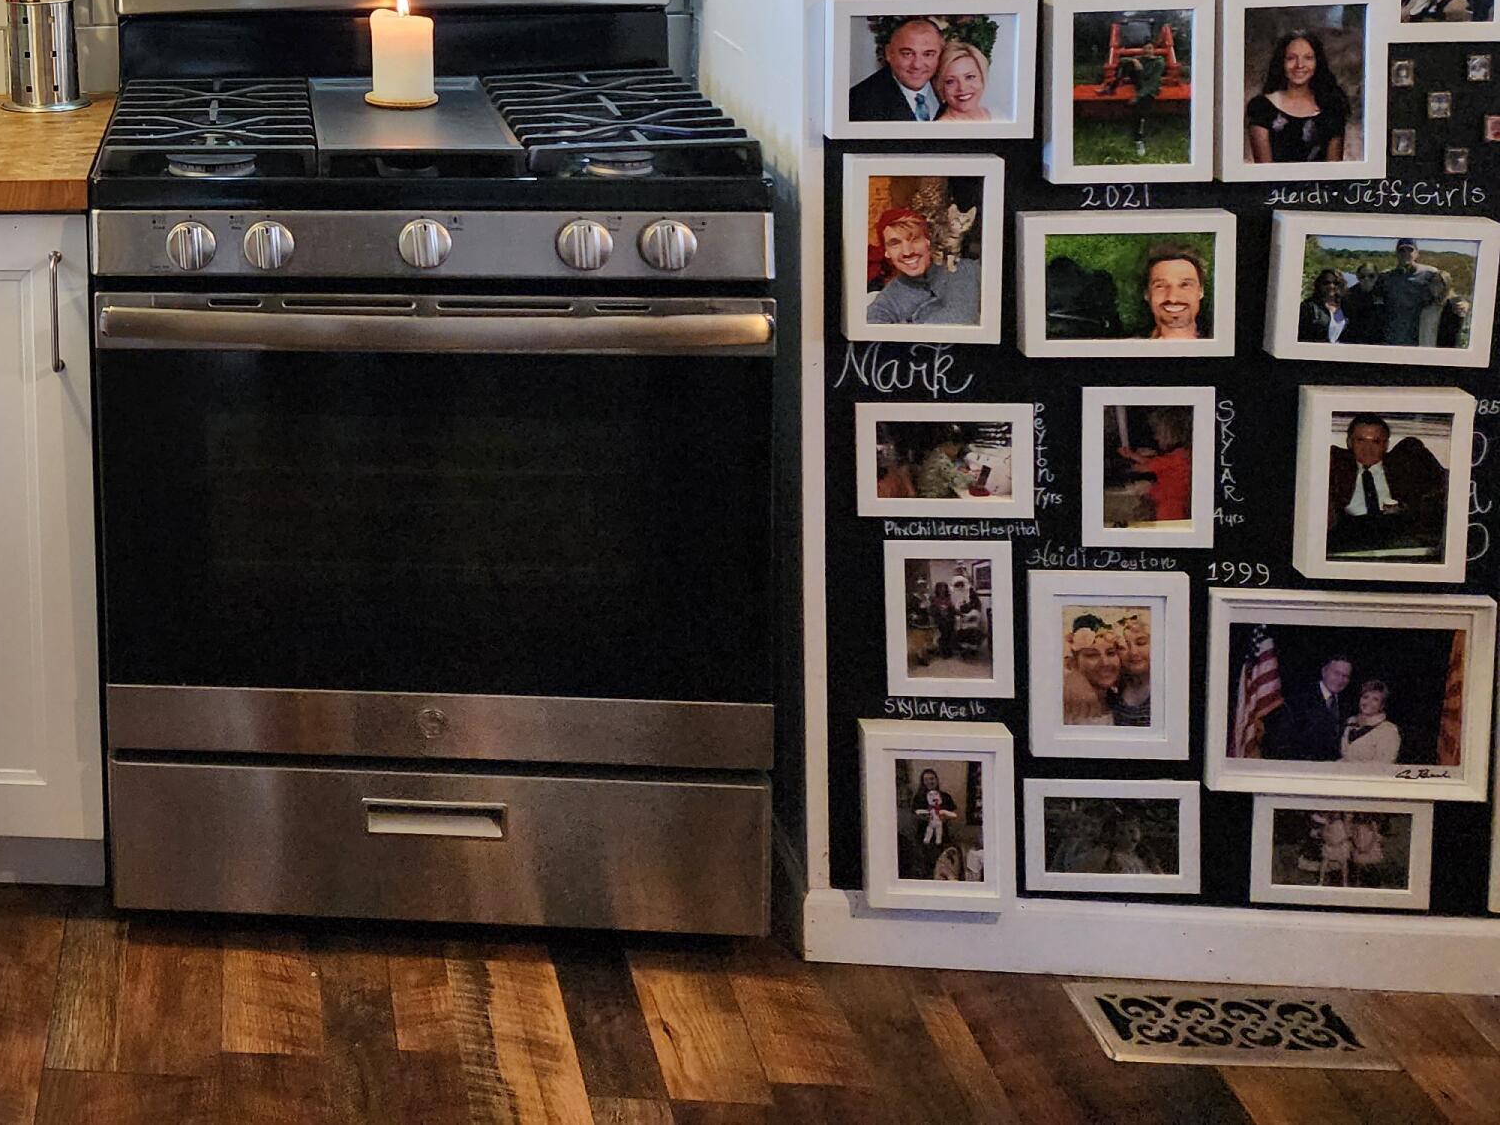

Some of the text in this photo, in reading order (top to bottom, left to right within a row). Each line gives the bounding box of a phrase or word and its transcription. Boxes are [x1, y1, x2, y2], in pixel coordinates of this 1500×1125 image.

[1080, 182, 1150, 208] 2021
[832, 341, 974, 399] Mark
[1025, 539, 1177, 570] Heidi Peyton
[1205, 561, 1270, 586] 1999
